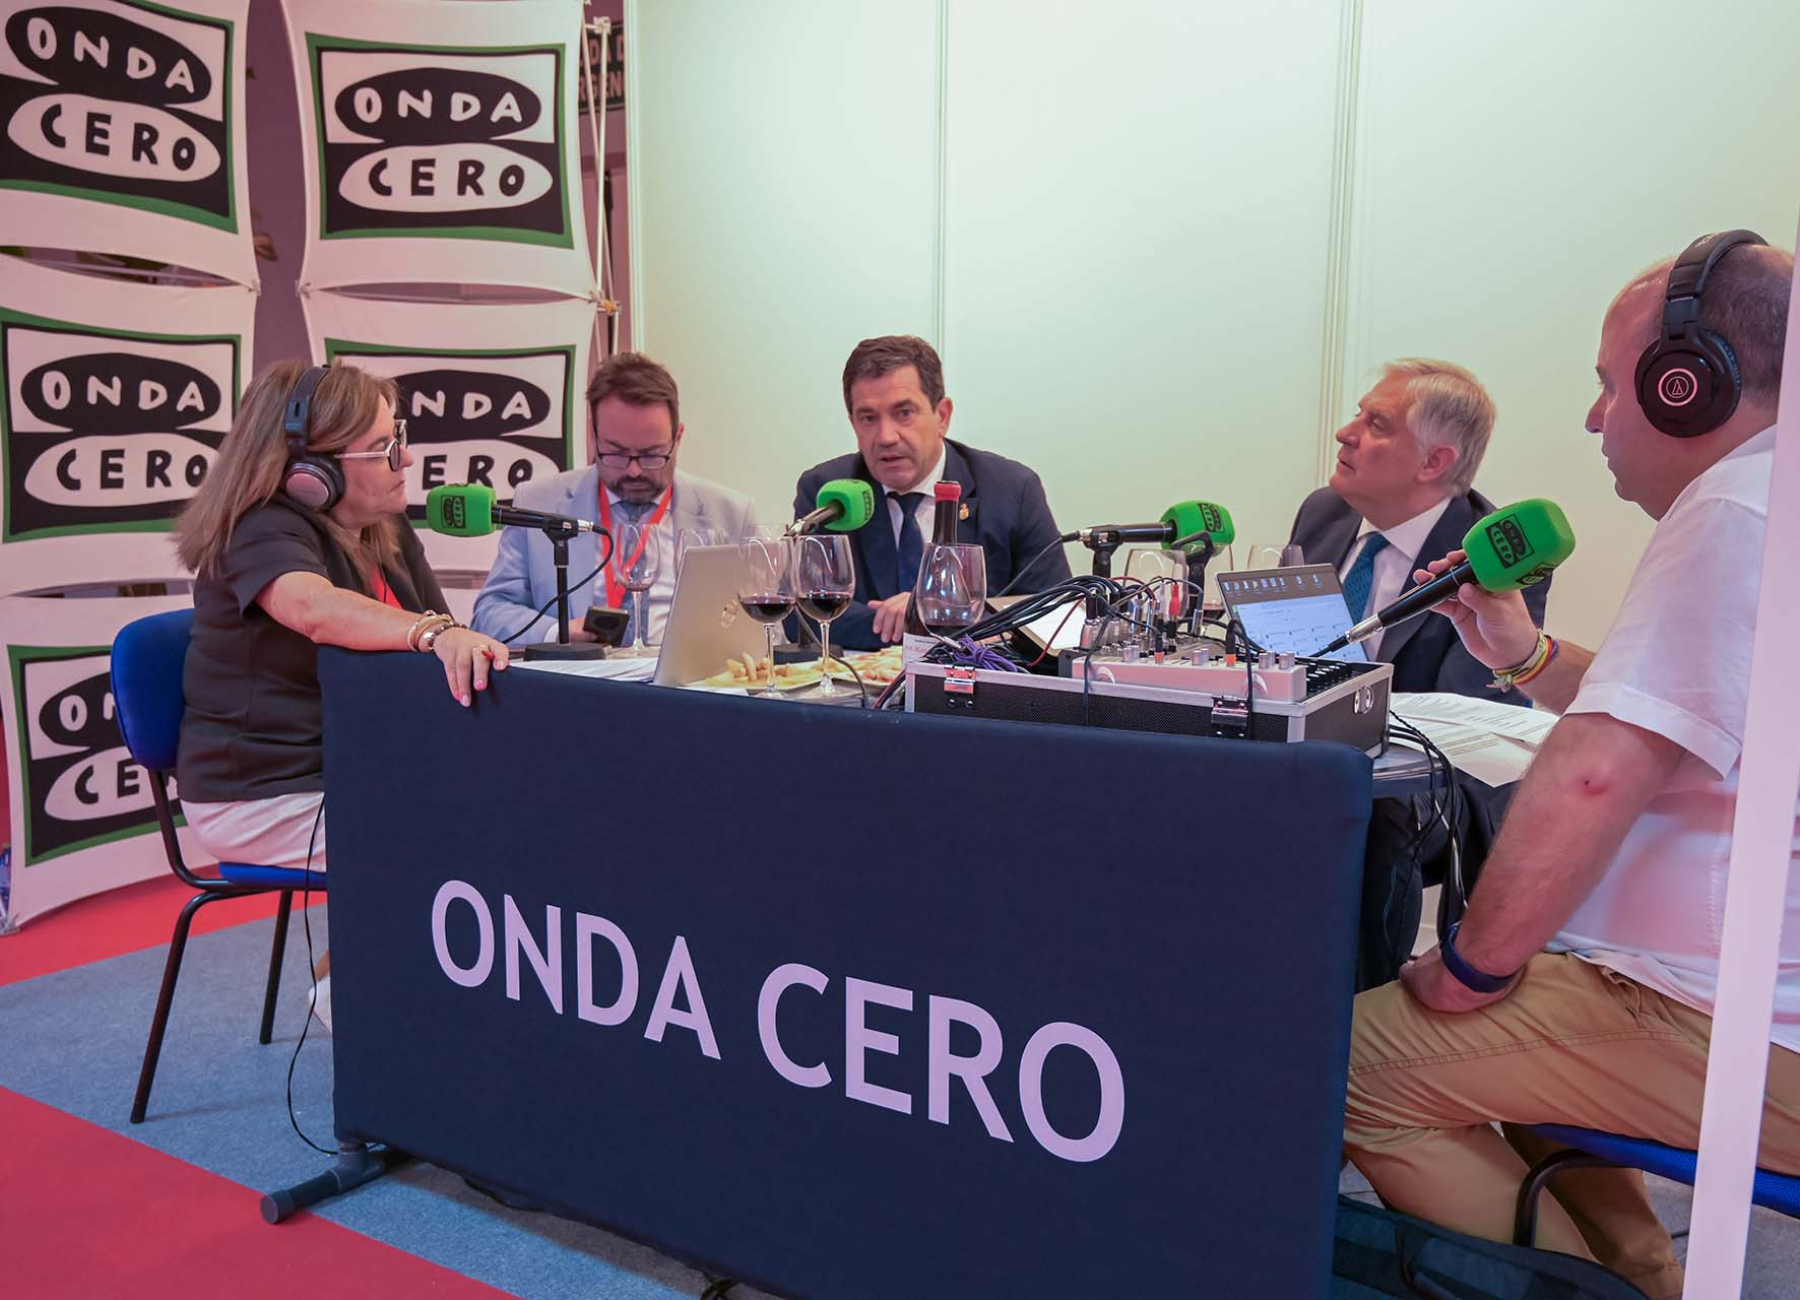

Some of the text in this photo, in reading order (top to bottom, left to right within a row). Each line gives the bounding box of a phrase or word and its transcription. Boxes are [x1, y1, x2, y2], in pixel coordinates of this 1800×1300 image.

[26, 16, 196, 95] ONDA
[353, 87, 524, 124] ONDA
[40, 102, 198, 171] CERO
[368, 157, 526, 197] CERO
[41, 370, 206, 412] ONDA
[411, 389, 533, 420] NDA
[56, 447, 208, 490] CERO
[422, 455, 533, 490] ERO
[74, 757, 140, 805] CE
[432, 880, 1126, 1164] ONDA CERO
